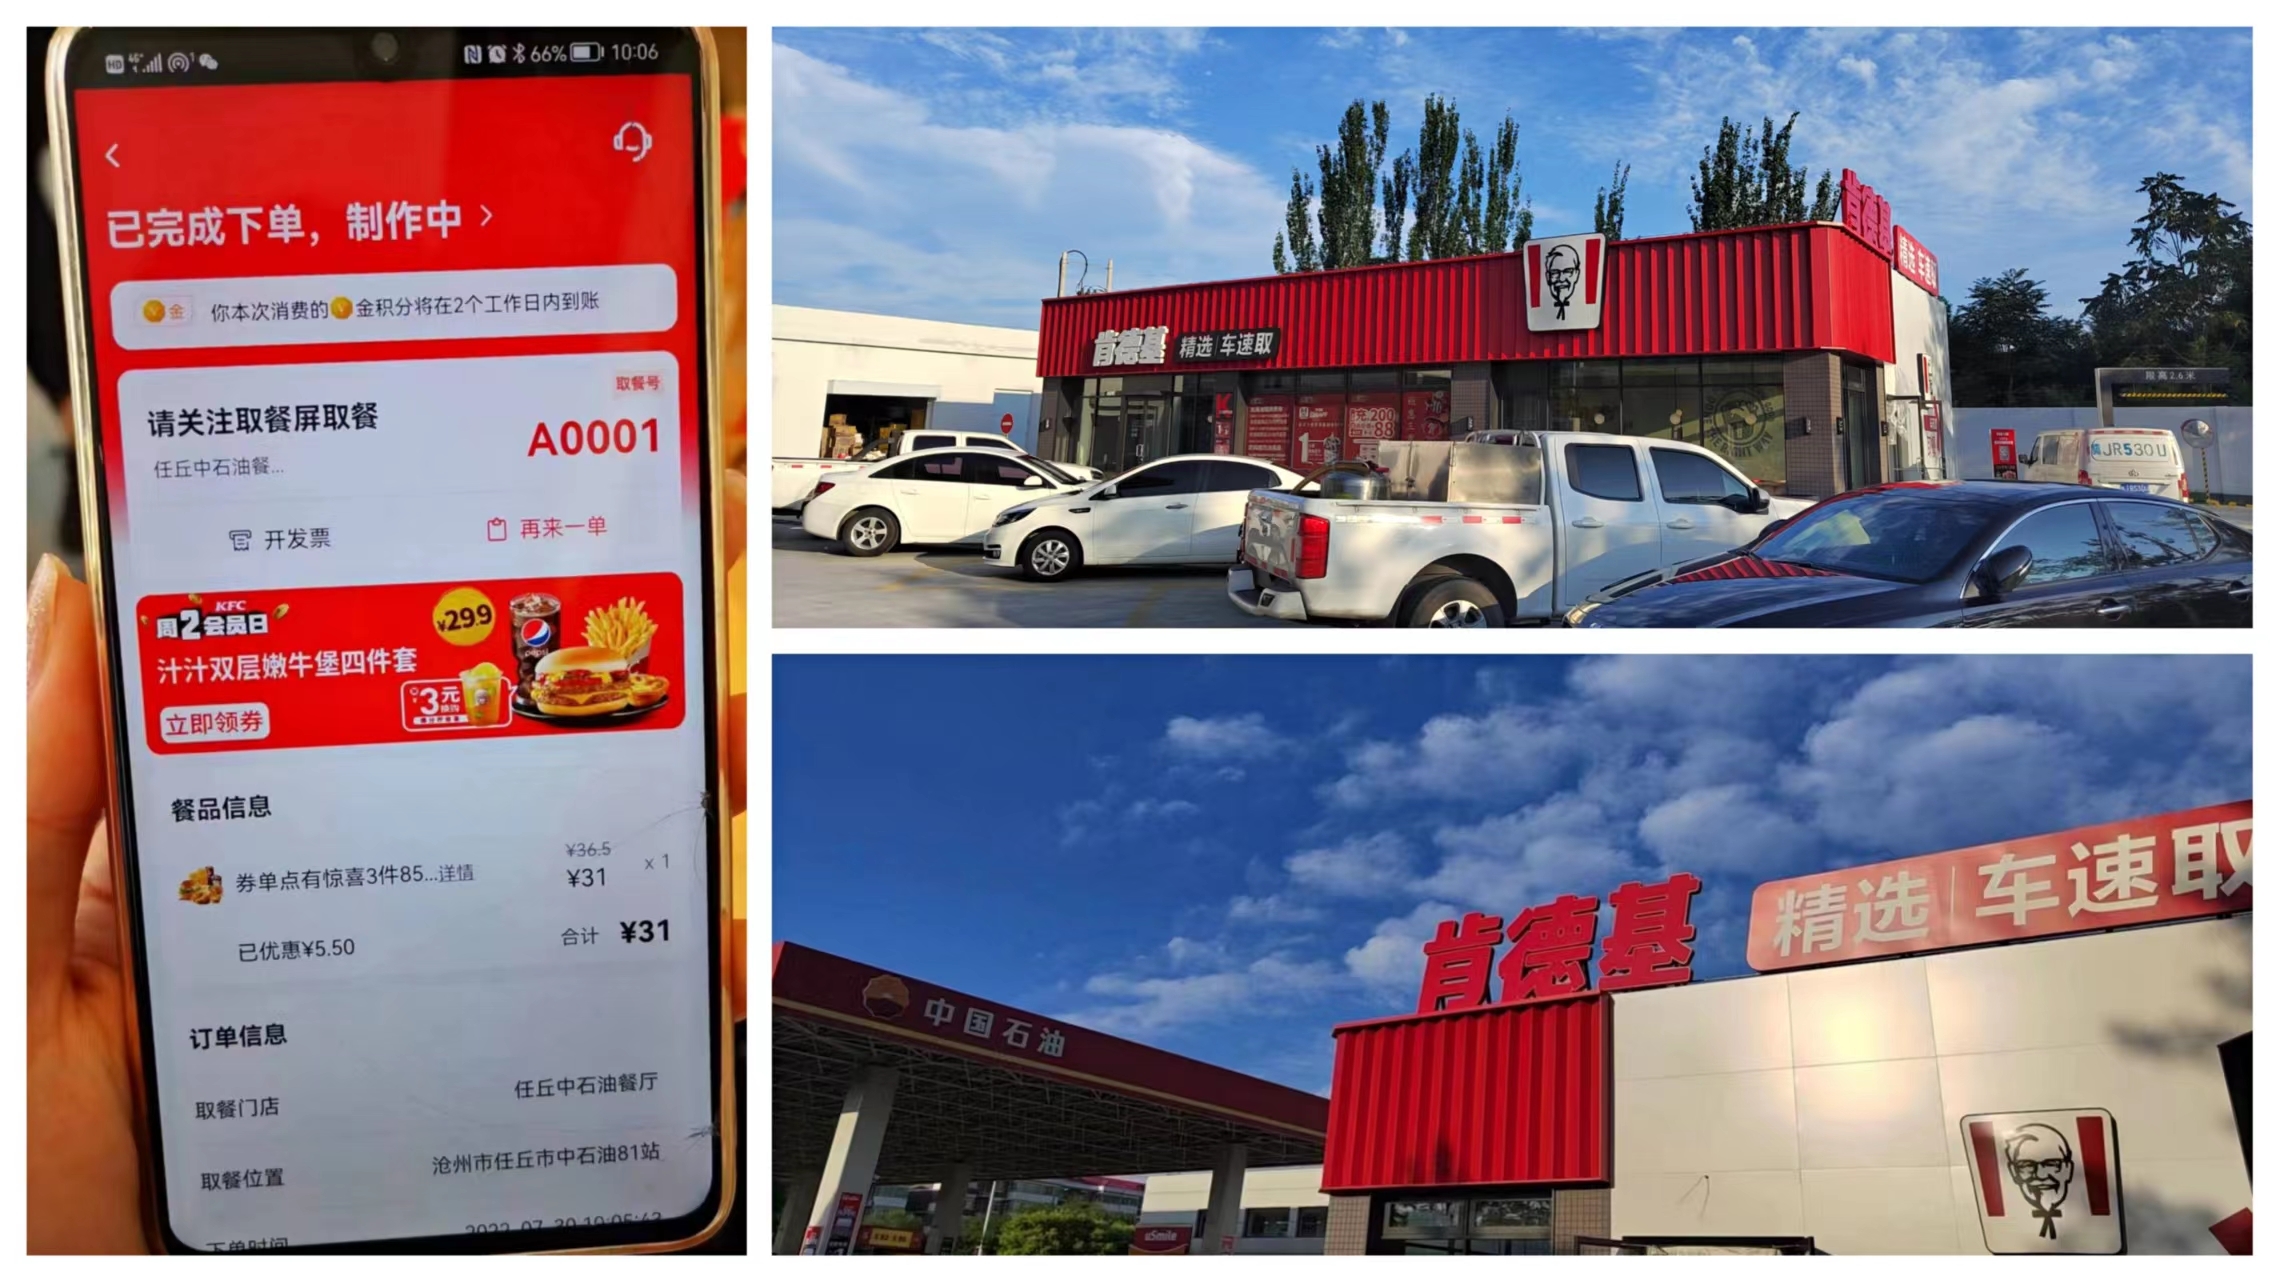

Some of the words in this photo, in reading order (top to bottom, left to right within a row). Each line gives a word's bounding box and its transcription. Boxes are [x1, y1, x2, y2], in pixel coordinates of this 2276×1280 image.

[530, 45, 568, 63] 66%
[612, 43, 659, 61] 10:06
[1841, 167, 1892, 257] 肯德基
[169, 303, 185, 320] 金
[210, 301, 329, 323] 你本次消费的
[356, 290, 600, 319] 金积分将在2个工作日内到账
[1092, 325, 1169, 367] 肯德基
[1179, 334, 1214, 360] 精选
[1219, 331, 1274, 357] 车速取
[615, 374, 661, 392] 取餐号
[147, 402, 379, 438] 请关注取餐屏取餐
[1370, 408, 1394, 422] 200
[527, 418, 660, 458] A0001
[1374, 421, 1394, 437] 88
[264, 528, 332, 551] 开发票
[520, 515, 608, 541] 再来一单
[215, 600, 247, 612] KFC
[437, 603, 493, 632] ¥29.9
[156, 609, 269, 641] 周2会员日
[157, 646, 418, 685] 汁汁双层嫩牛堡四件套
[165, 710, 264, 736] 立即领券
[171, 795, 273, 824] 餐品信息
[565, 841, 612, 857] ¥36.5
[438, 863, 475, 883] 详情
[567, 867, 606, 888] ¥31
[1771, 869, 1931, 959] 精选
[1975, 818, 2253, 930] 车速取
[561, 926, 599, 946] 合计
[620, 918, 670, 943] ¥31
[1418, 872, 1703, 1015] 肯德基
[238, 937, 356, 963] 已优惠¥5.50
[189, 1023, 288, 1050] 订单信息
[924, 996, 1067, 1060] 中国石油
[514, 1071, 659, 1100] 任丘中石油餐厅
[195, 1096, 280, 1121] 取餐门店
[431, 1141, 661, 1175] 沧州市任丘市中石油81站
[200, 1167, 285, 1191] 取餐位置
